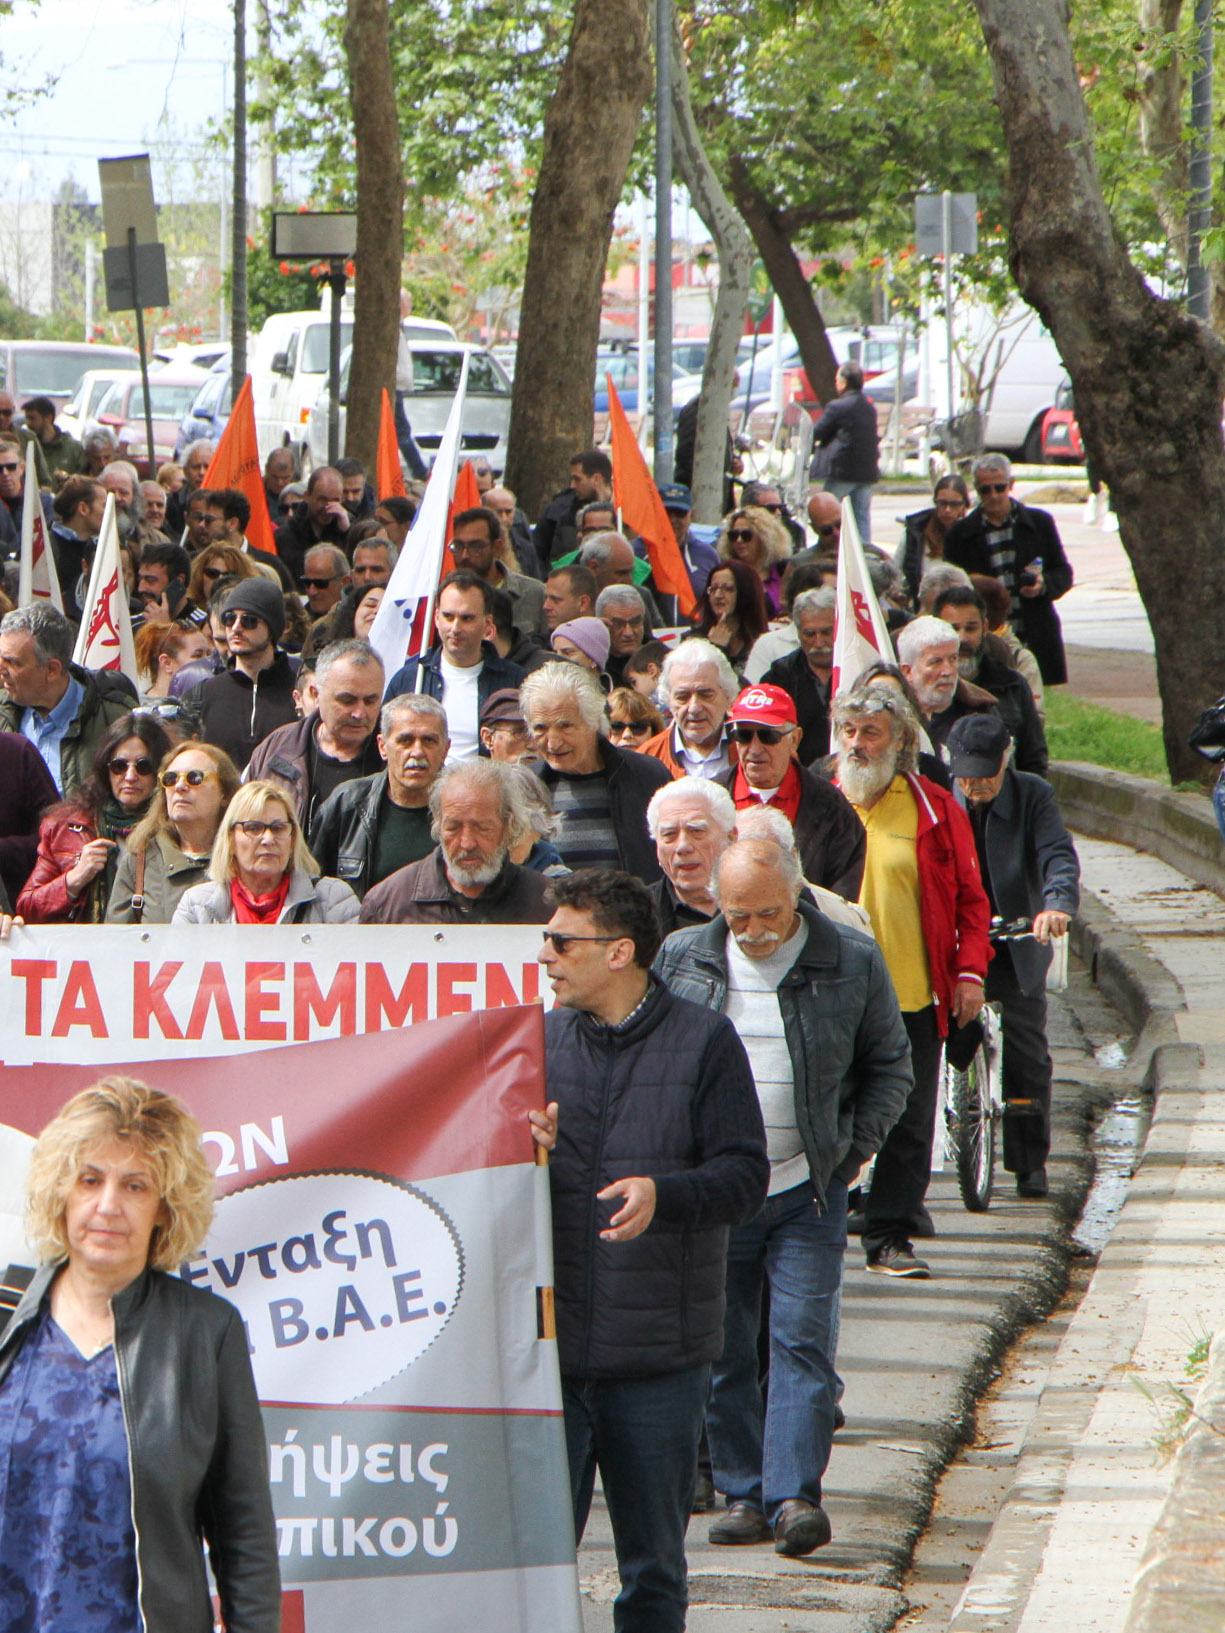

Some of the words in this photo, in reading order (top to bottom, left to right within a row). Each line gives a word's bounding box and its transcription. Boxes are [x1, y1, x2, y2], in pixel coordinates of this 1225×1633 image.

[10, 959, 108, 1039] ΤΑ
[133, 960, 561, 1041] ΚΛΕΜΜΕΝ
[202, 1116, 289, 1178] ΩΝ
[271, 1430, 450, 1497] ήψεις
[277, 1502, 459, 1558] πικού
